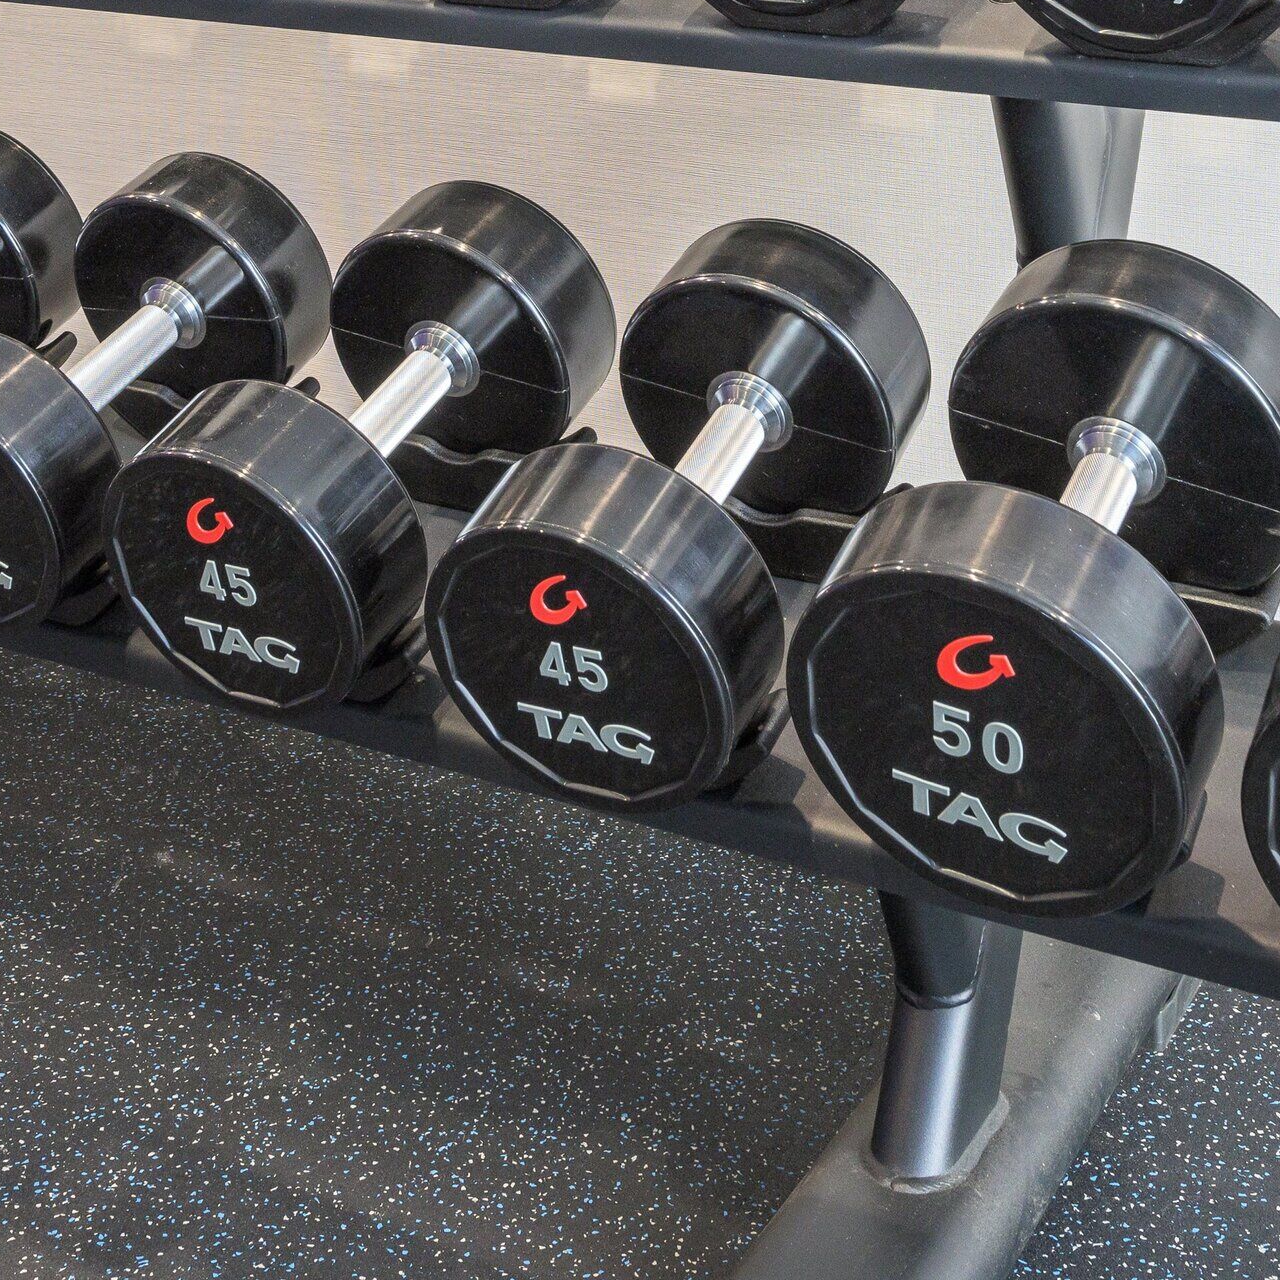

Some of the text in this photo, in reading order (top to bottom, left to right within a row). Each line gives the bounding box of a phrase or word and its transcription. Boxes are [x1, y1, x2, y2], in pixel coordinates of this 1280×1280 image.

[199, 559, 258, 607] 45
[183, 616, 301, 674] TAG
[539, 640, 609, 693] 45
[516, 701, 656, 766] TAG
[932, 699, 1024, 775] 50
[891, 767, 1069, 865] TAG
